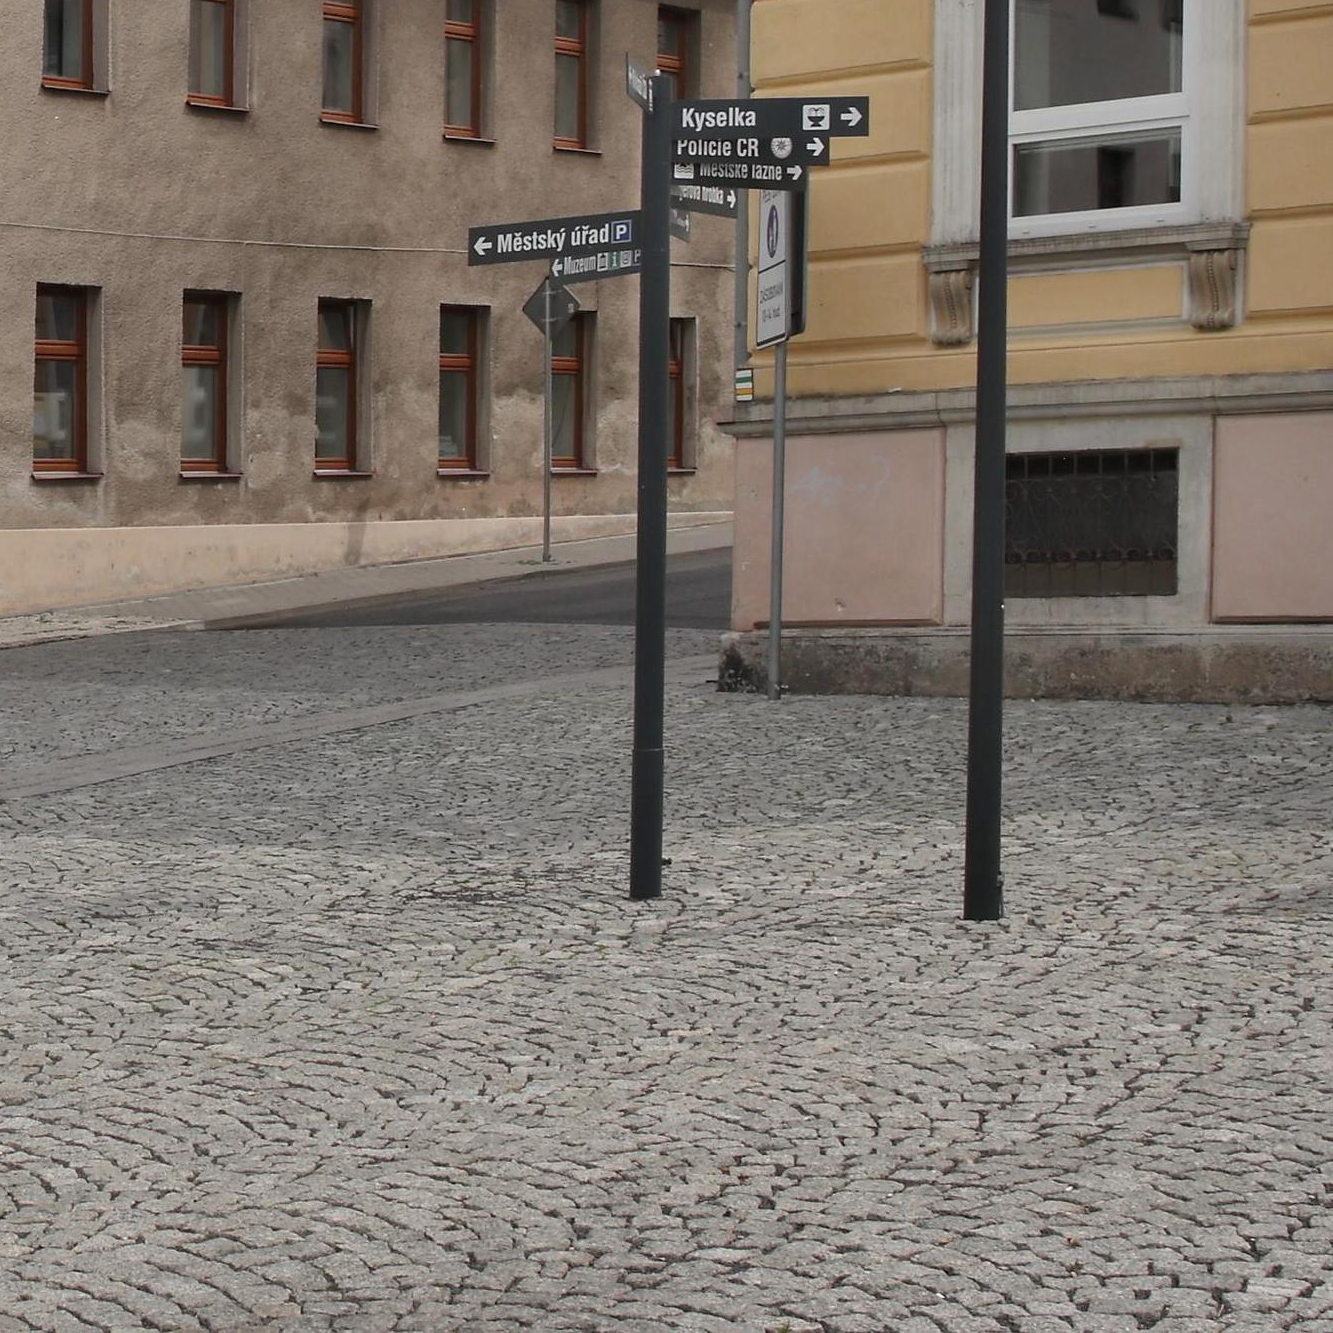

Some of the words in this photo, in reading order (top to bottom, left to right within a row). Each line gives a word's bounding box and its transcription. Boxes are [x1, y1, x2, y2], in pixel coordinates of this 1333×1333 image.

[682, 107, 756, 132] Kyselka
[677, 139, 731, 156] Policie
[497, 228, 567, 254] Městský
[571, 223, 610, 246] úřad
[563, 255, 597, 276] Muzeum
